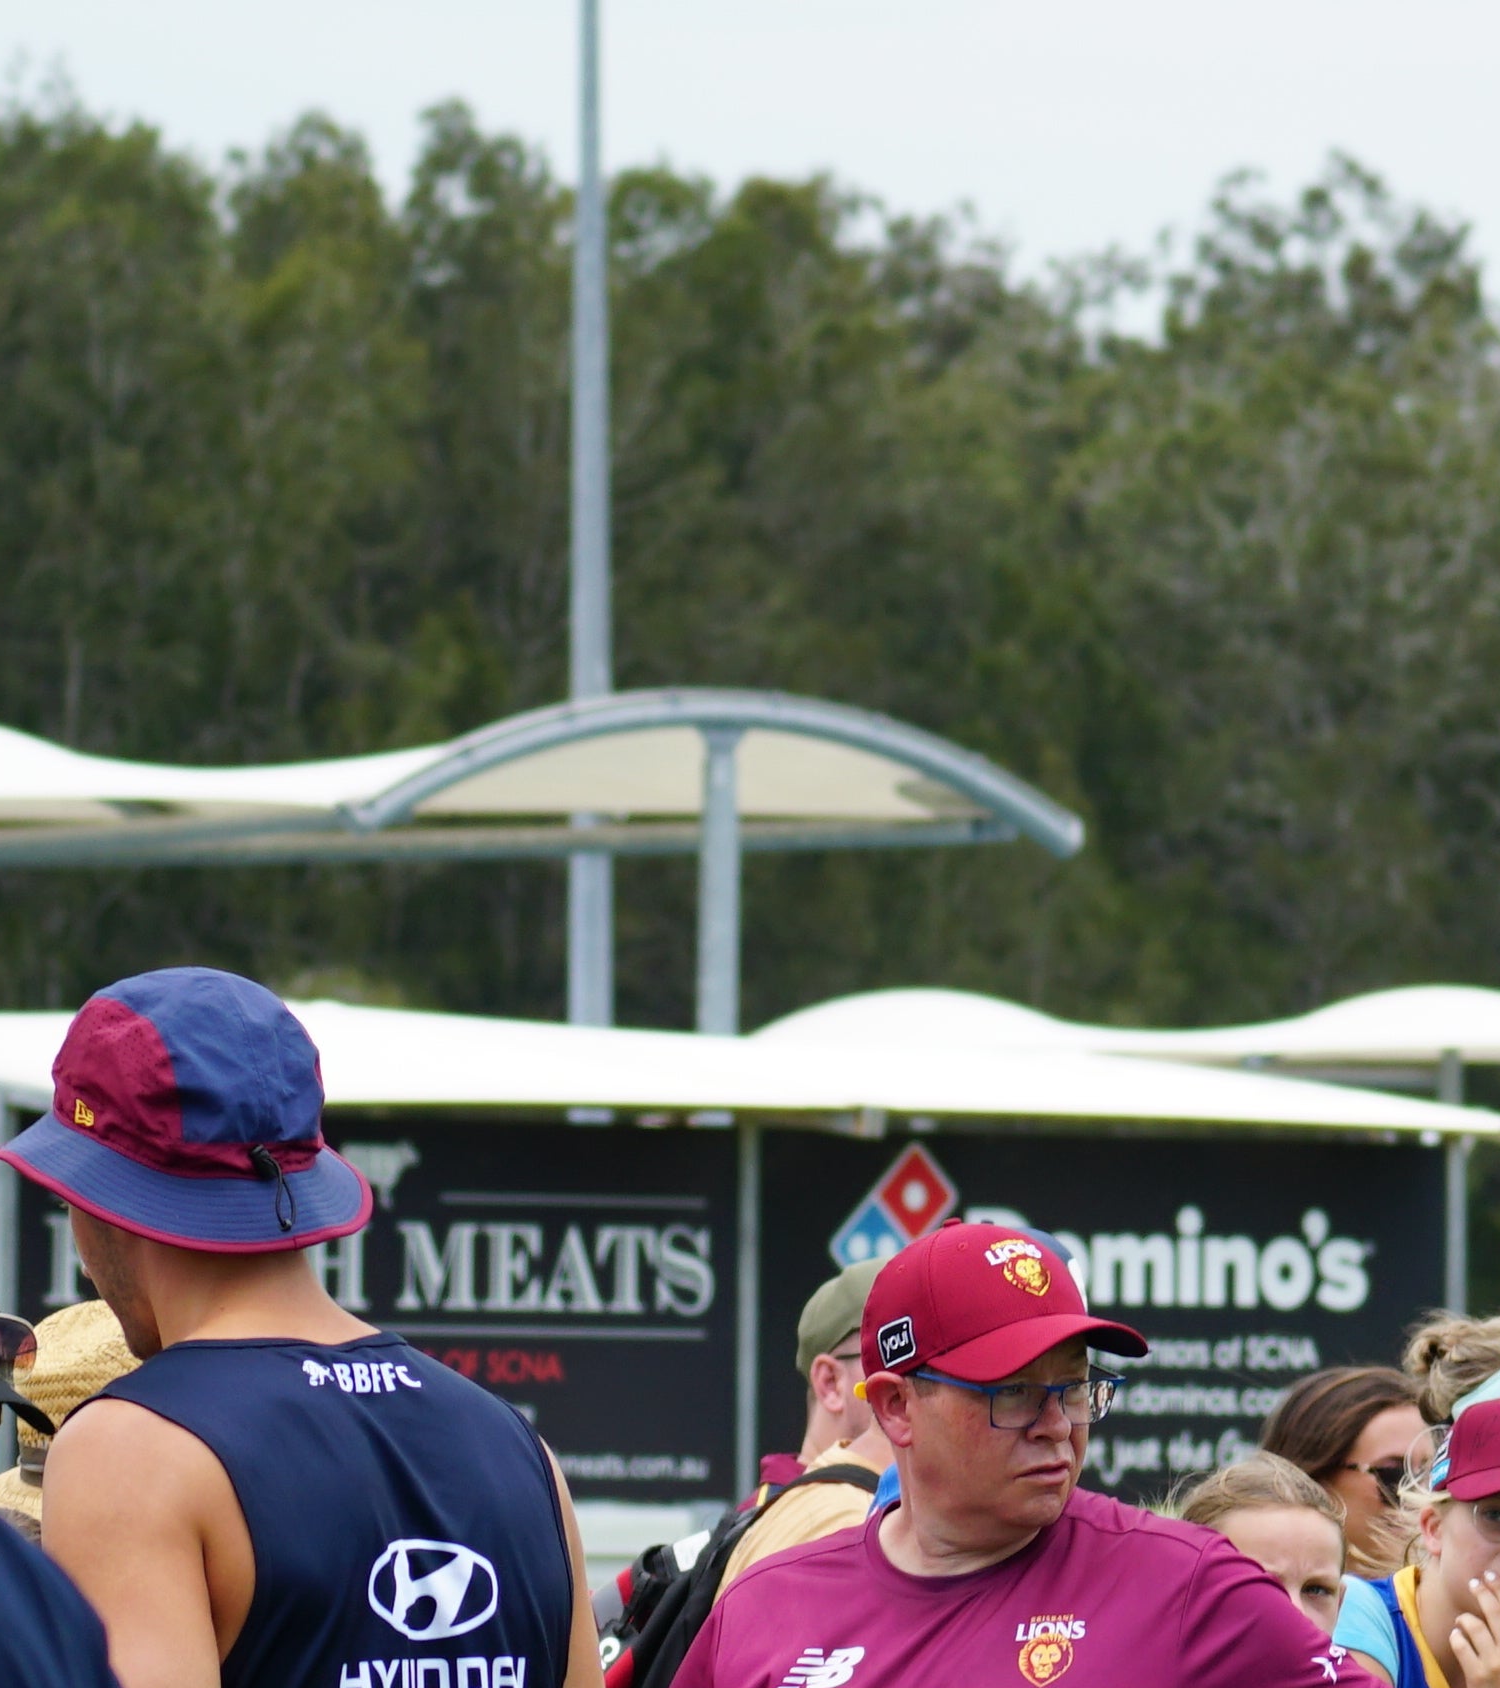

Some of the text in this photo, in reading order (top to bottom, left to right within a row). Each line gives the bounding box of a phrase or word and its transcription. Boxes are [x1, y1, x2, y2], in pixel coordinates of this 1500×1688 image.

[389, 1220, 716, 1316] MEATS
[881, 1322, 910, 1361] youi
[331, 1361, 422, 1394] BBFFC
[1015, 1620, 1076, 1642] LIONS
